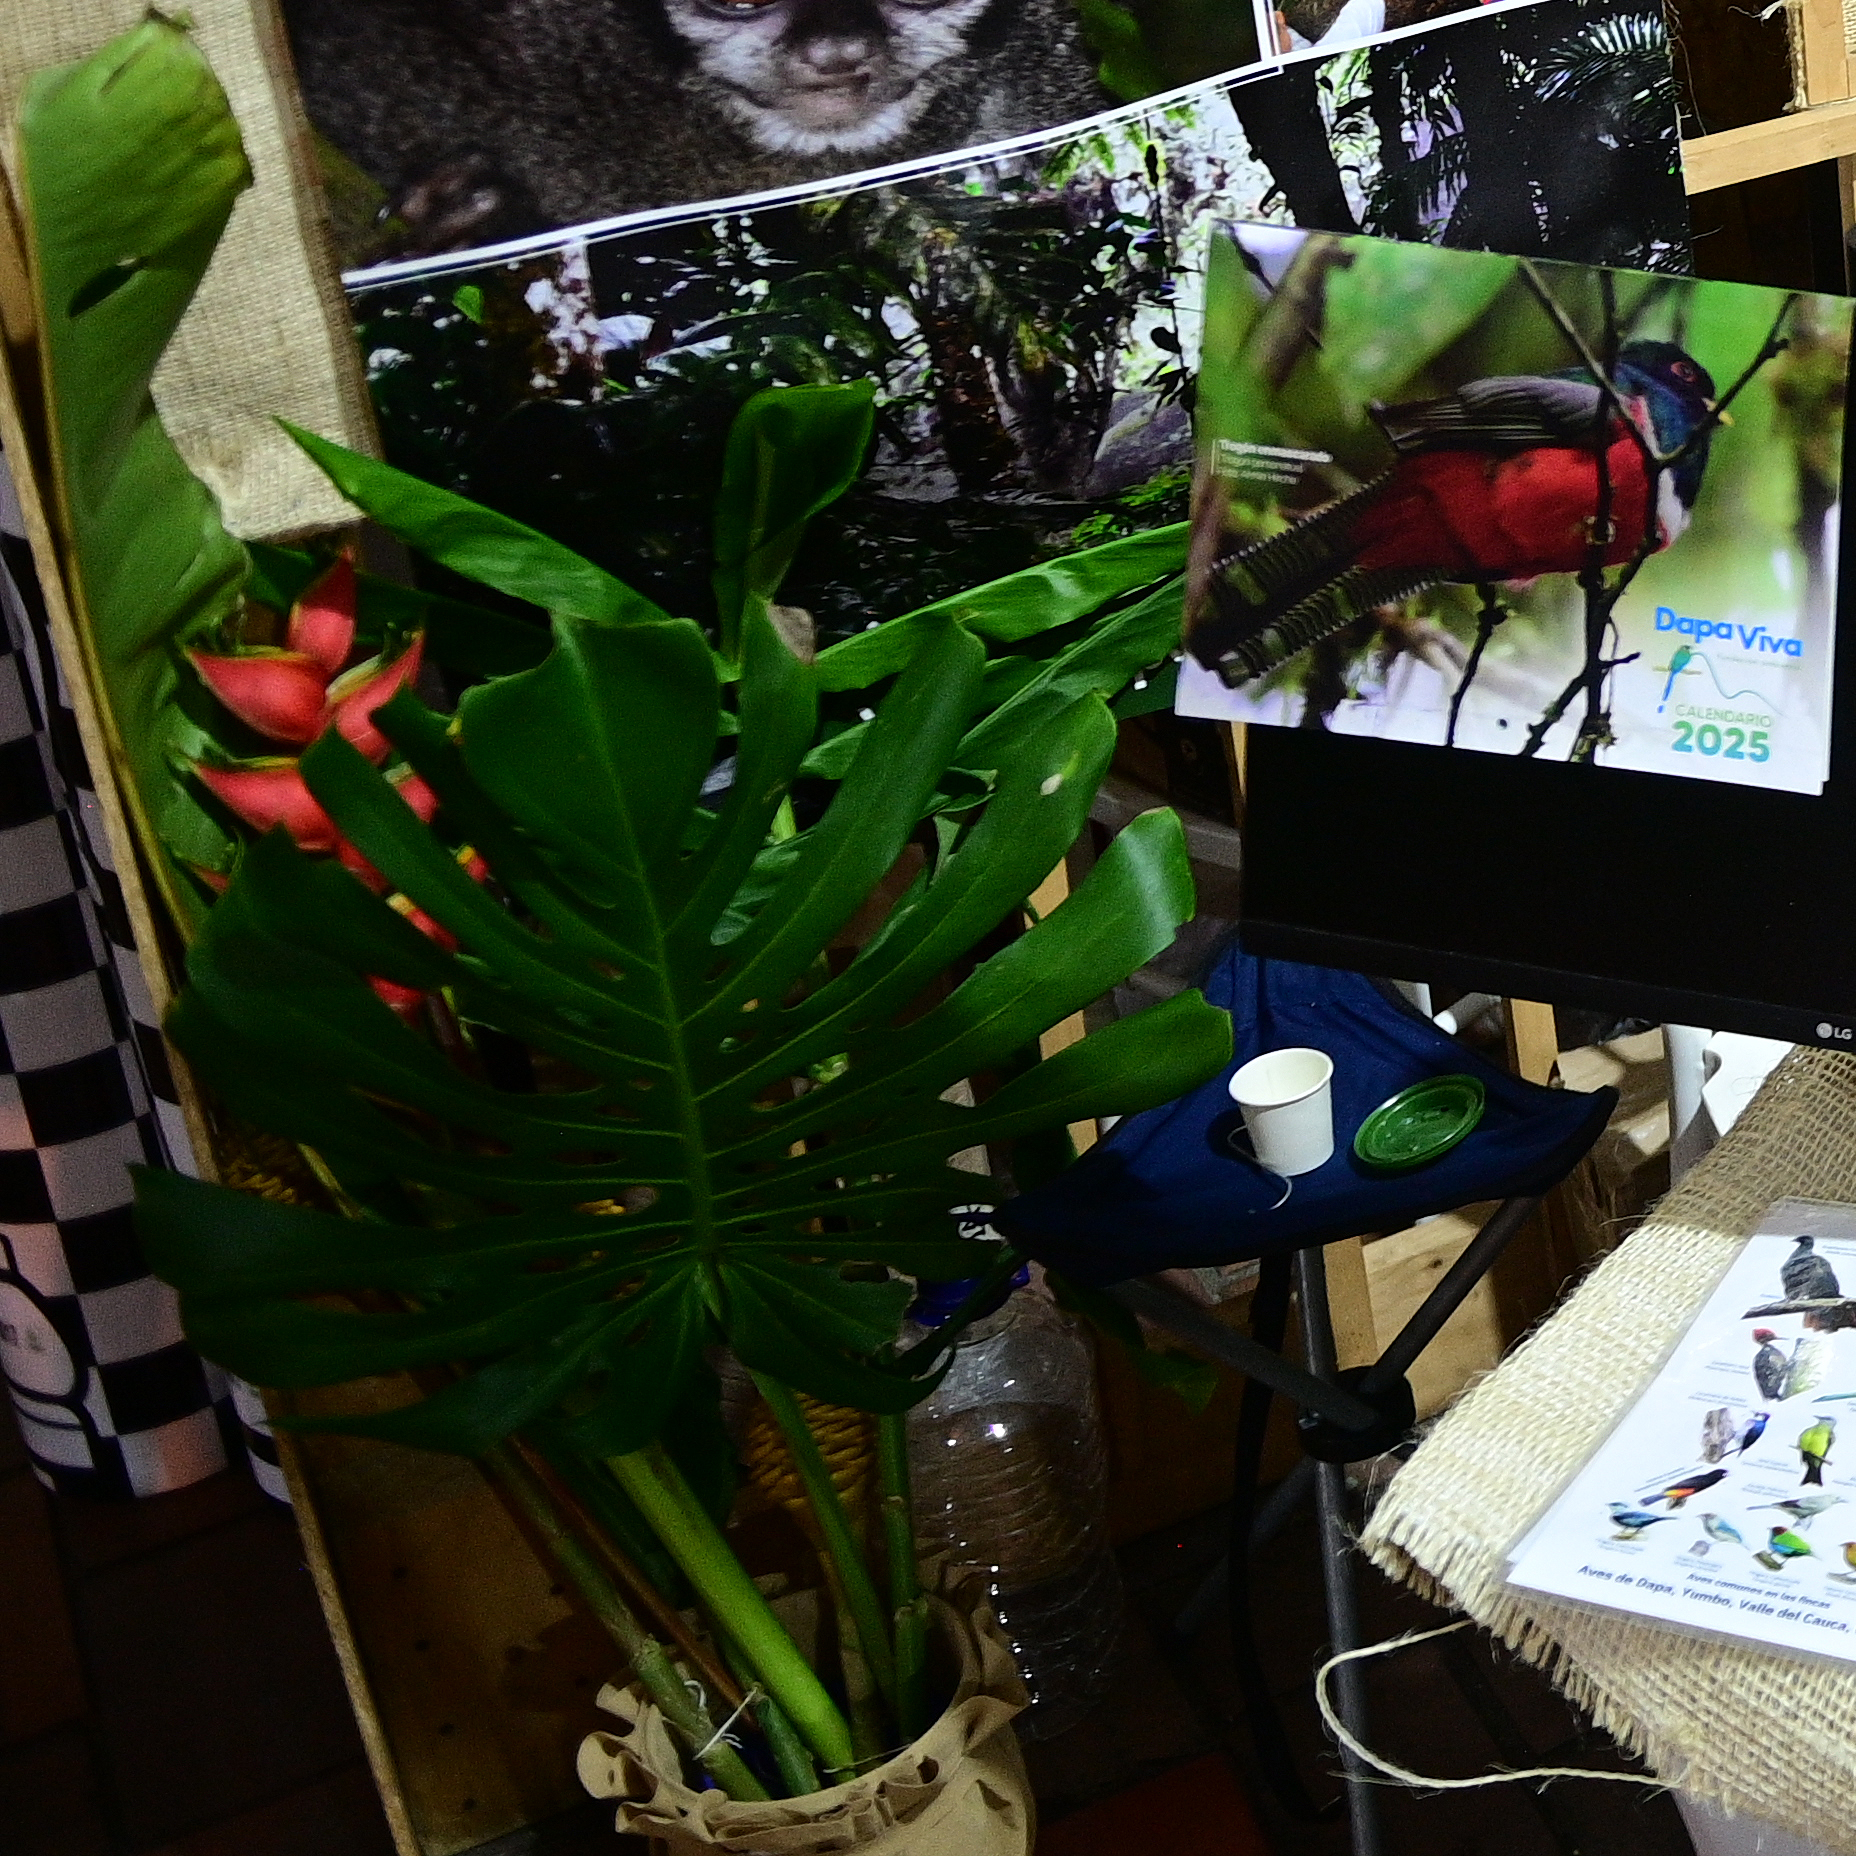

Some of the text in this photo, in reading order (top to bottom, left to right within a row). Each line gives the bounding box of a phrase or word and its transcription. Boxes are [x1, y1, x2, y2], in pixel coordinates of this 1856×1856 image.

[1655, 606, 1805, 658] Dapa Viva
[1674, 703, 1773, 728] CALENDARIO
[1671, 719, 1771, 763] 2025
[1834, 1027, 1853, 1041] LG
[1577, 1564, 1614, 1583] Aves
[1615, 1572, 1634, 1586] de
[1635, 1577, 1676, 1597] Dapa,
[1682, 1586, 1734, 1609] Yumbo,
[1739, 1599, 1775, 1617] Valle
[1776, 1606, 1801, 1623] del
